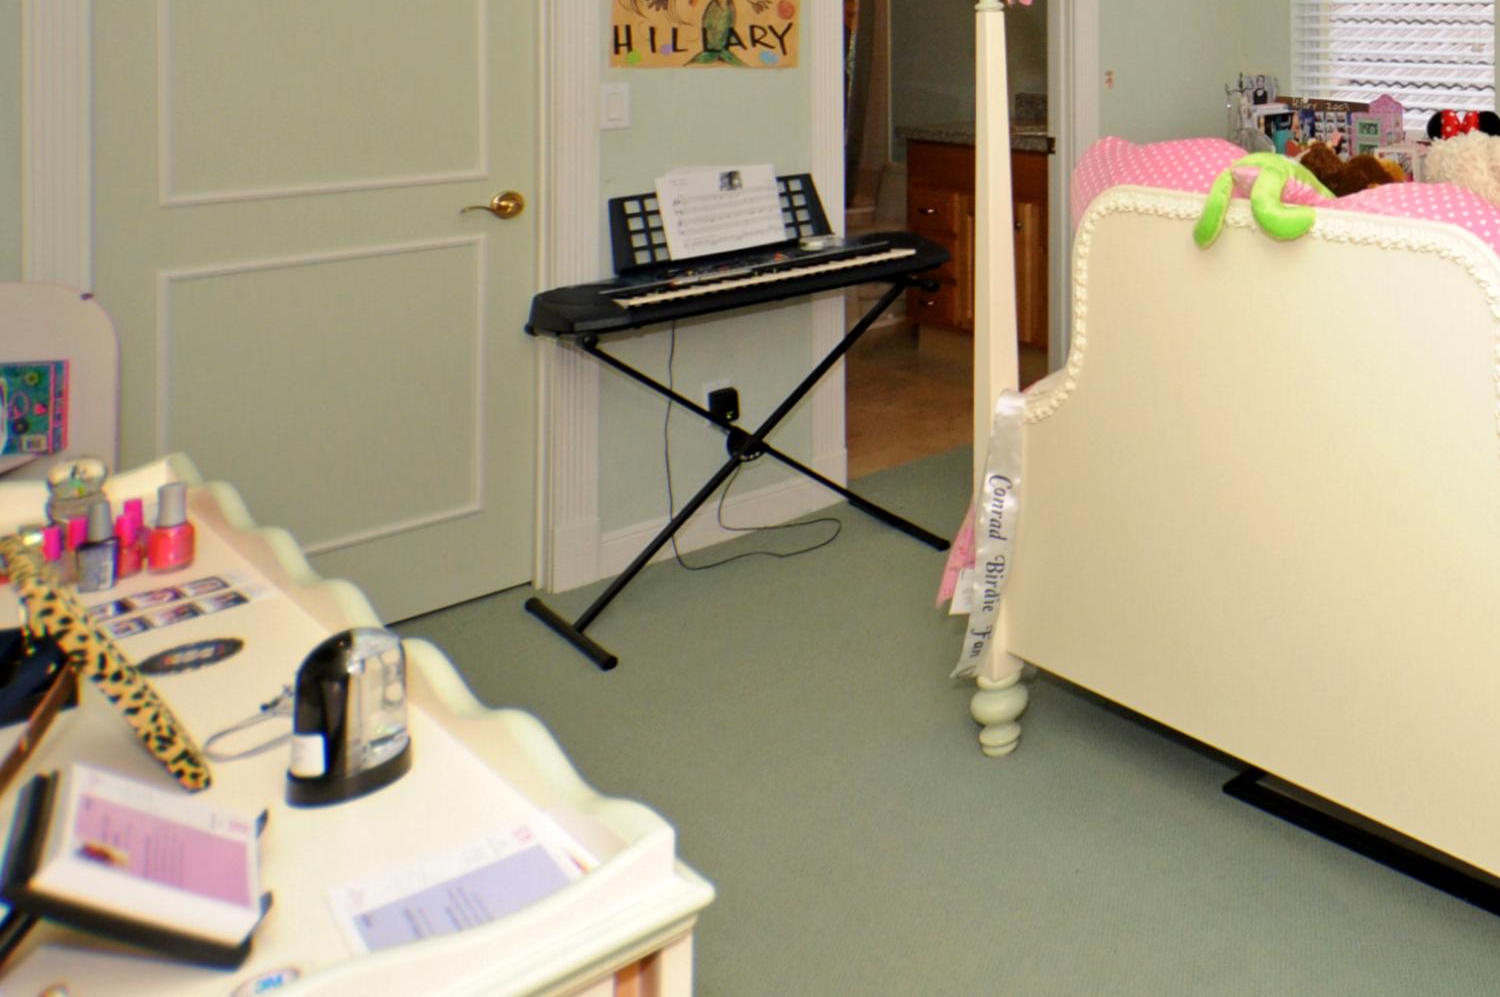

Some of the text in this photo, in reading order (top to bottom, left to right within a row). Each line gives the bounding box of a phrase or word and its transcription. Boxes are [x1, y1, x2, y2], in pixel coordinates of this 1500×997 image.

[613, 22, 794, 56] HILLARY
[969, 474, 1012, 659] Conrad Birdie Fan
